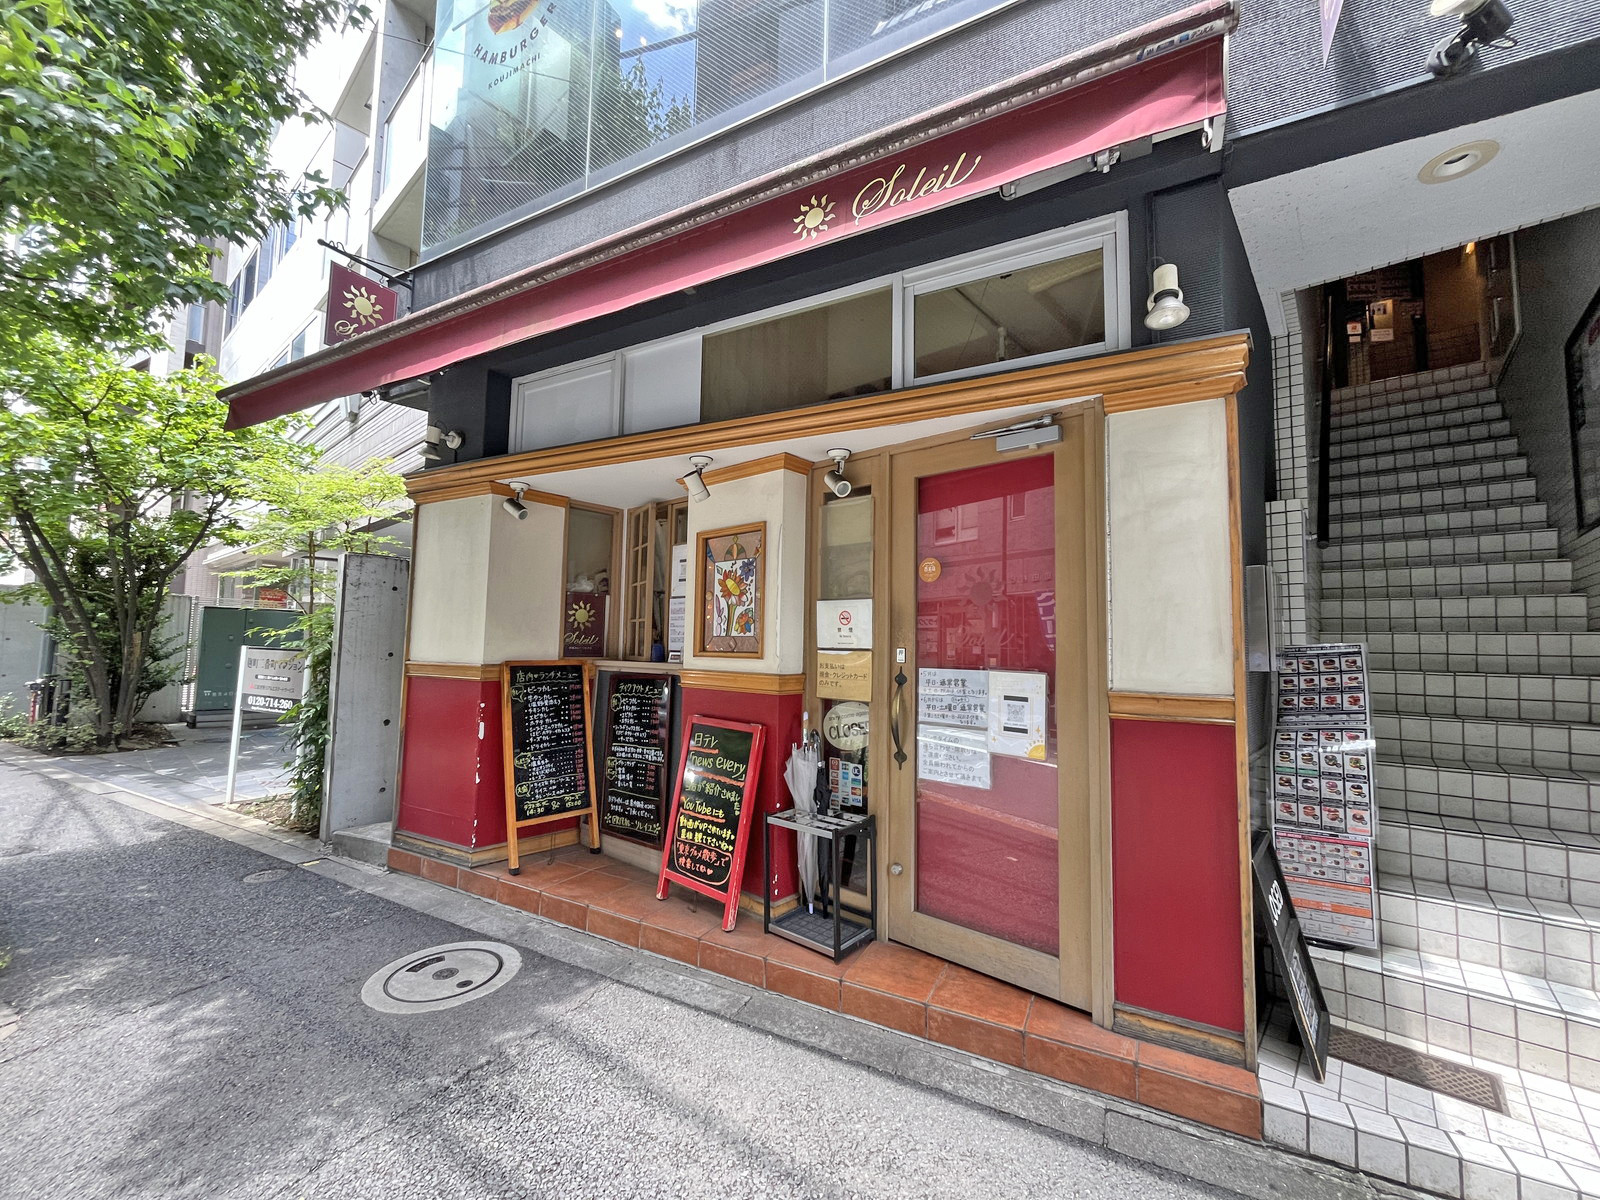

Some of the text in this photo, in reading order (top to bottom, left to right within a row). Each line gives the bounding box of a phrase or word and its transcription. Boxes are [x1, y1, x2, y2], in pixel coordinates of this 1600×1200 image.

[474, 2, 557, 65] HAMBURGER
[488, 53, 541, 90] KOUJIMACHI
[852, 152, 982, 226] Soleil
[563, 631, 599, 645] Soleil
[819, 671, 868, 680] 現金・クレジットカード
[819, 680, 842, 688] のみです。
[247, 695, 293, 710] 0120-714-260
[694, 732, 719, 748] 日テレ
